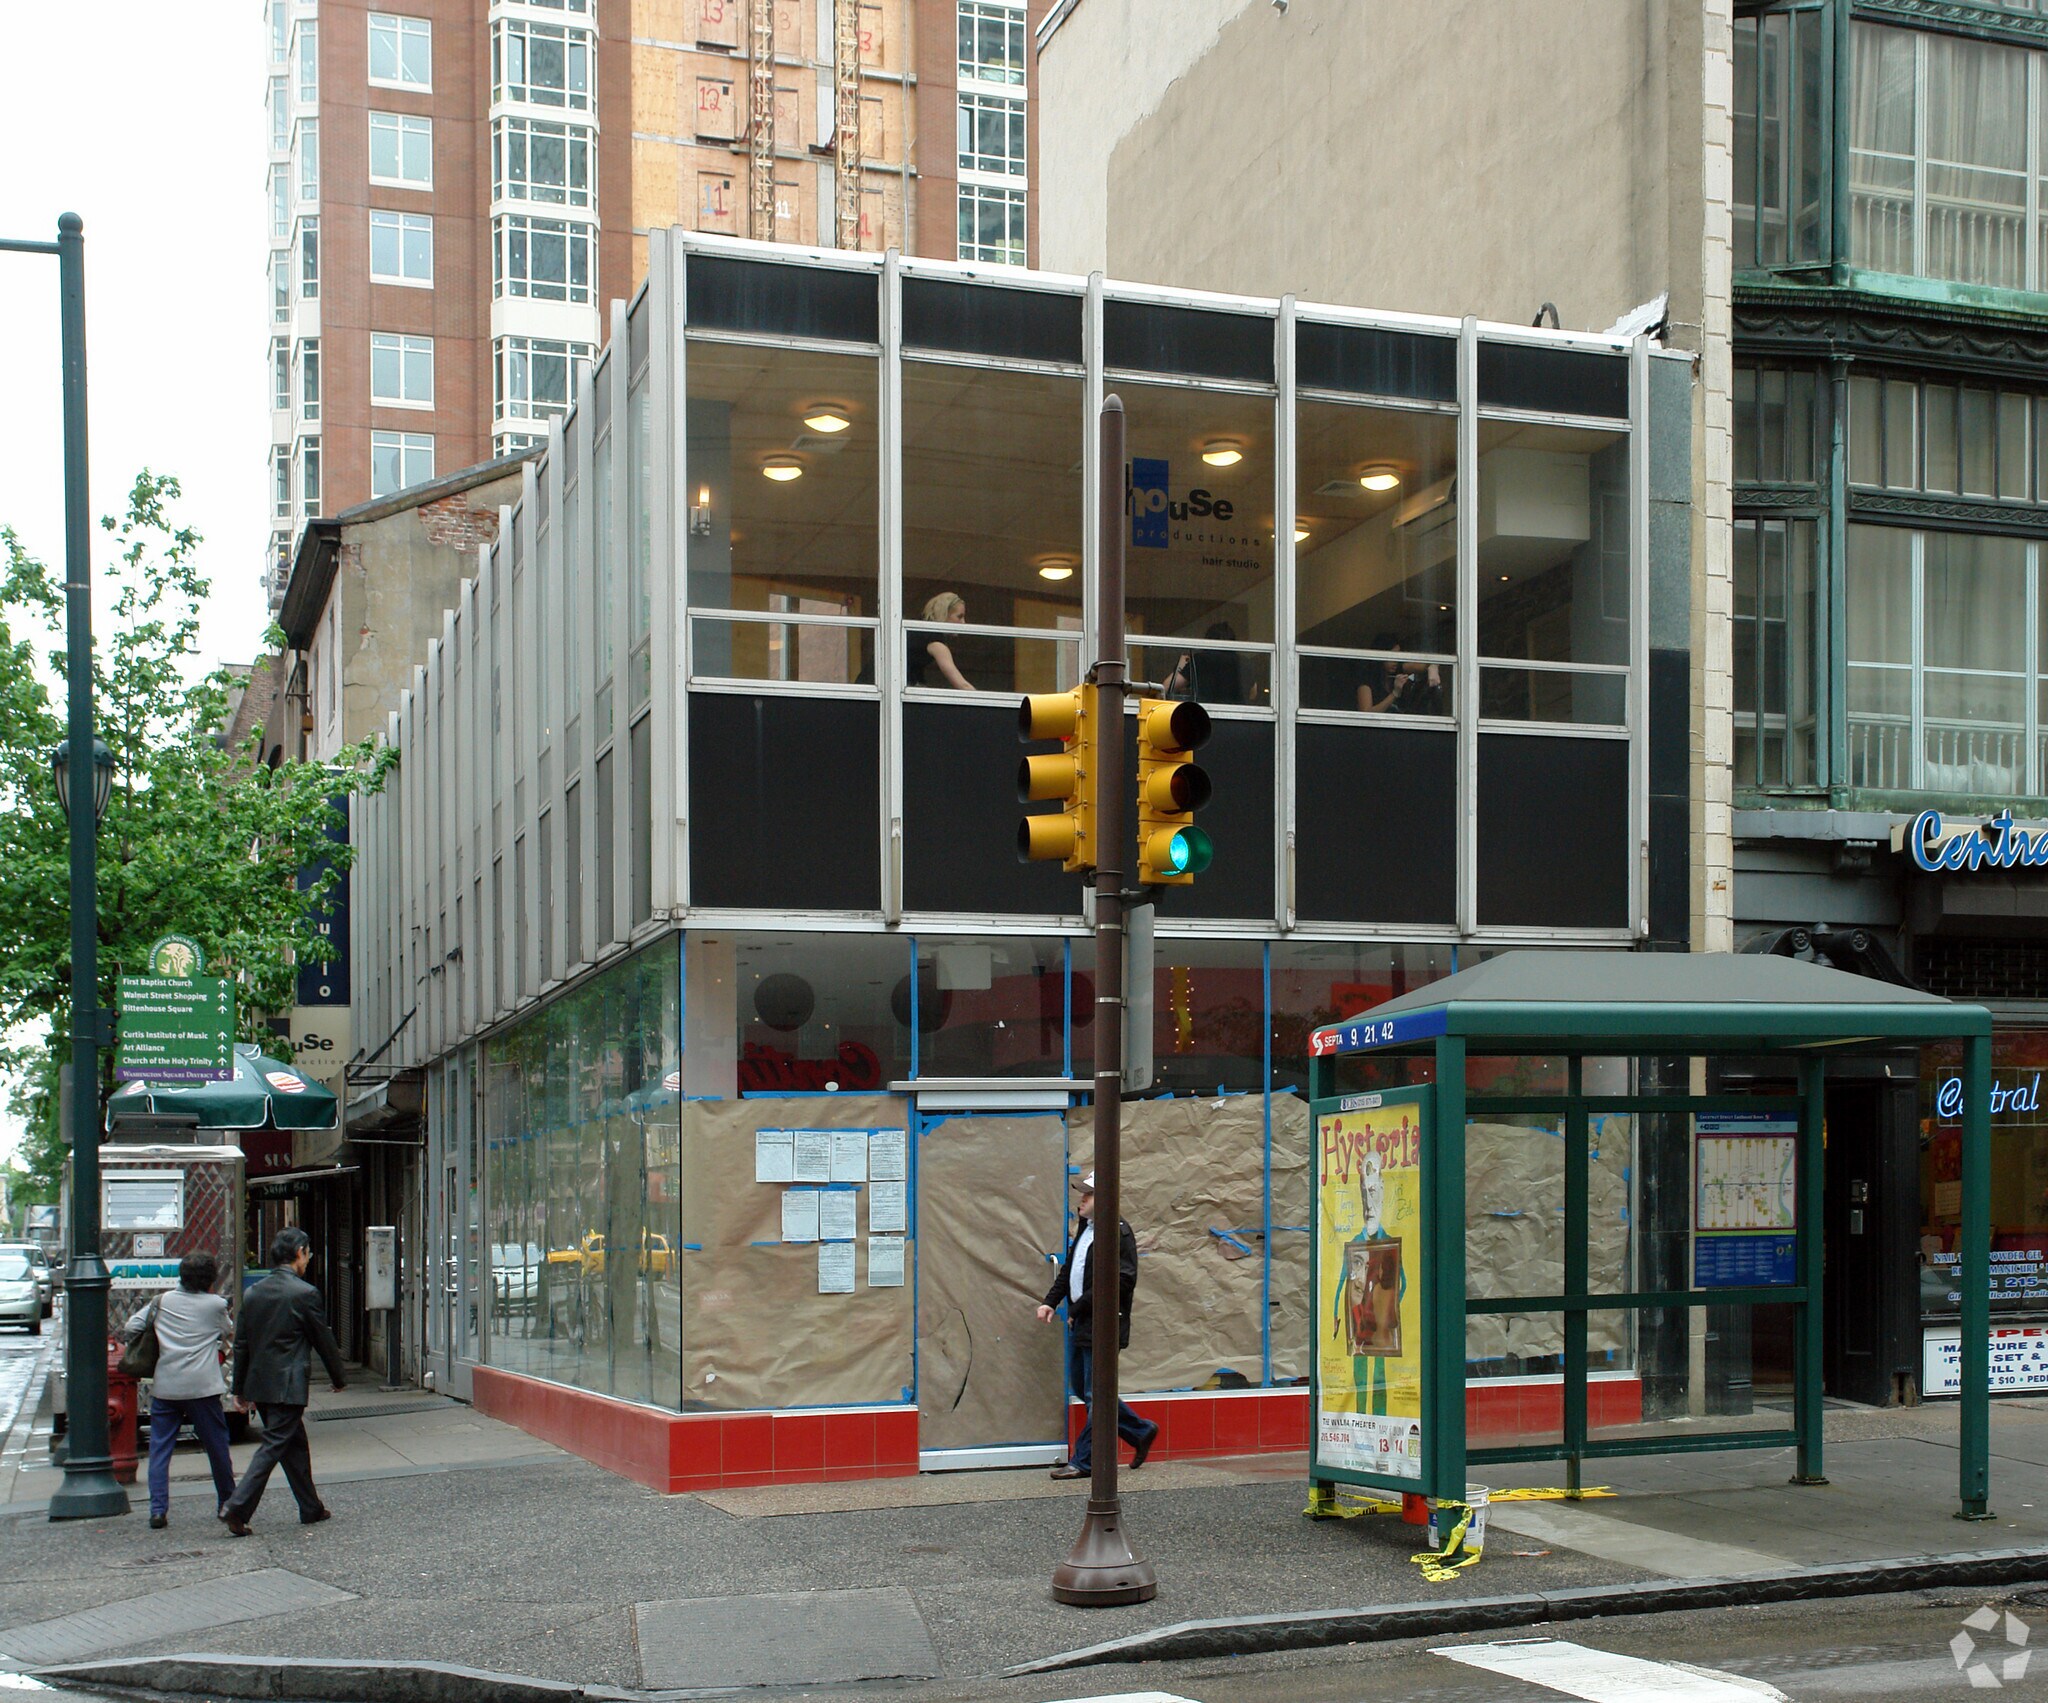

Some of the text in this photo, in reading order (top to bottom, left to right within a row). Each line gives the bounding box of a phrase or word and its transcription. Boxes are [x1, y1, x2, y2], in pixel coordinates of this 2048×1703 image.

[699, 86, 722, 112] 12
[702, 184, 728, 216] 11
[775, 200, 791, 219] 11
[1137, 528, 1260, 546] productions
[1202, 556, 1260, 569] hair studio
[122, 978, 193, 987] First Baptist Church
[123, 991, 208, 1001] Walnut Street Shopping
[122, 1005, 193, 1014] Rittenhouse Square
[146, 1031, 176, 1039] Institute
[178, 1031, 186, 1039] of
[1324, 1034, 1343, 1047] SEPTA
[1364, 1025, 1378, 1044] 21,
[1381, 1021, 1393, 1040] 42
[135, 1044, 165, 1052] Alliance
[158, 1057, 170, 1065] the
[171, 1057, 188, 1066] Holy
[189, 1058, 213, 1066] Trinity
[1937, 1072, 2040, 1117] Ctral
[1321, 1115, 1420, 1186] Hysteria
[1933, 1253, 1956, 1263] NAIL
[1988, 1251, 2025, 1262] OWDER
[2026, 1250, 2043, 1260] GEL
[1988, 1328, 2048, 1338] PE
[2035, 1341, 2045, 1349] &
[1993, 1352, 2041, 1362] SET &
[2021, 1364, 2031, 1372] &
[1998, 1376, 2016, 1385] $10
[1351, 1420, 1376, 1430] THEATER
[1379, 1438, 1390, 1453] 13
[1395, 1439, 1403, 1454] 14
